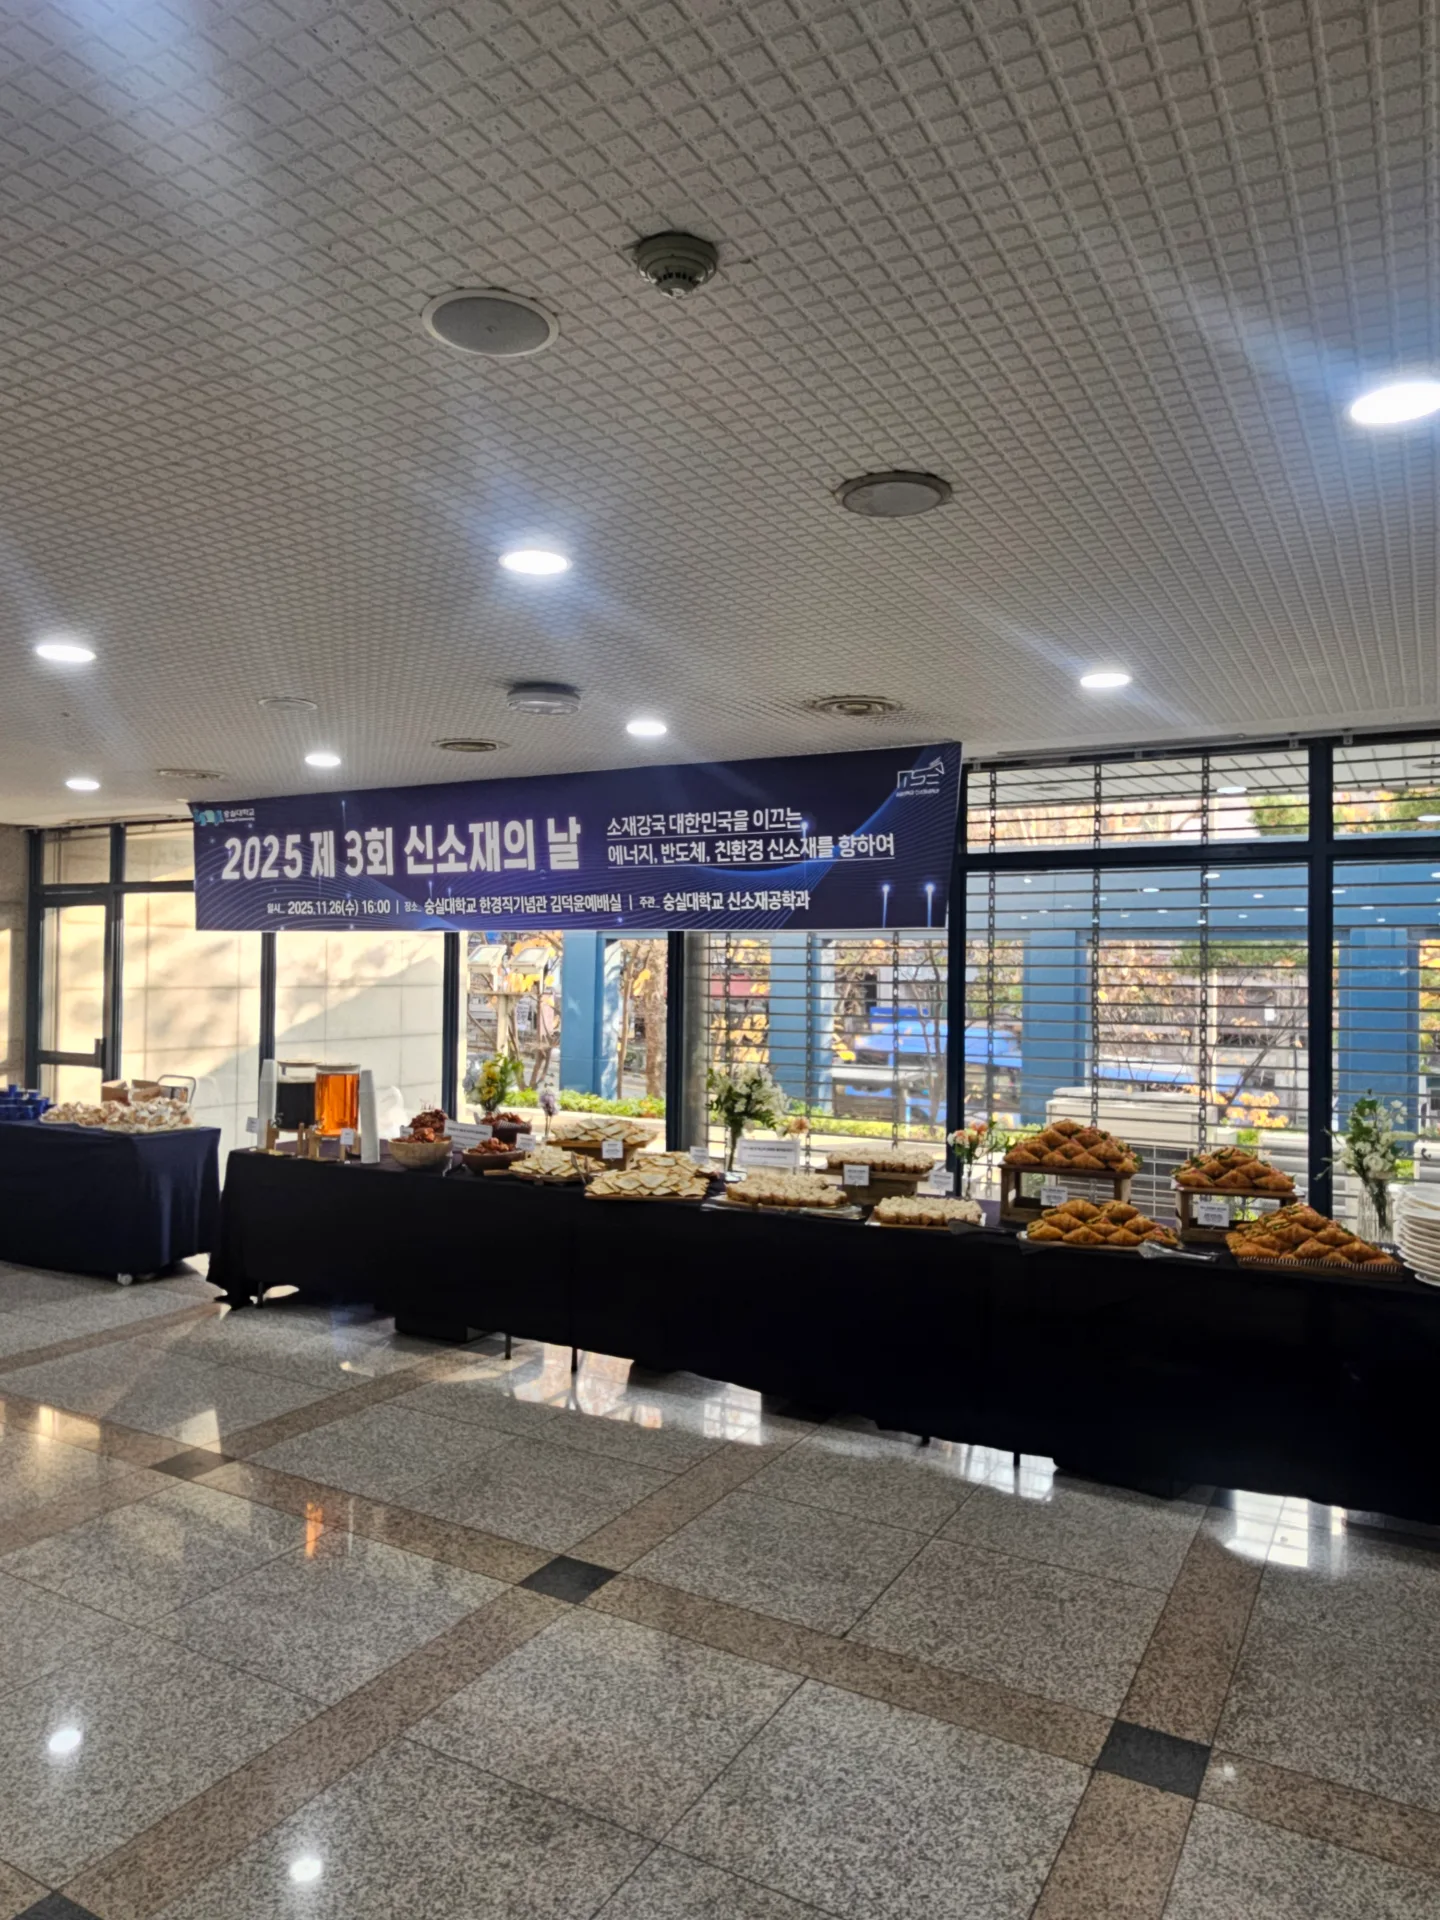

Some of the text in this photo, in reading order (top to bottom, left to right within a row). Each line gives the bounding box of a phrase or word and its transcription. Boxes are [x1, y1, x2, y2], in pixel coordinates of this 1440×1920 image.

[606, 807, 802, 837] 소재강국 대한민국을 이끄는
[221, 816, 581, 880] 2025 제 3회 신소재의 날
[608, 832, 895, 866] 에너지, 반도체, 친환경 신소재를 향하여
[287, 899, 359, 916] 2025.11.26(수)
[362, 899, 391, 914] 16:00
[424, 896, 477, 915] 숭실대학교
[479, 894, 547, 914] 한경직기념관
[550, 893, 622, 913] 김덕윤예배실
[663, 892, 724, 911] 숭실대학교
[727, 890, 810, 911] 신소재공학과
